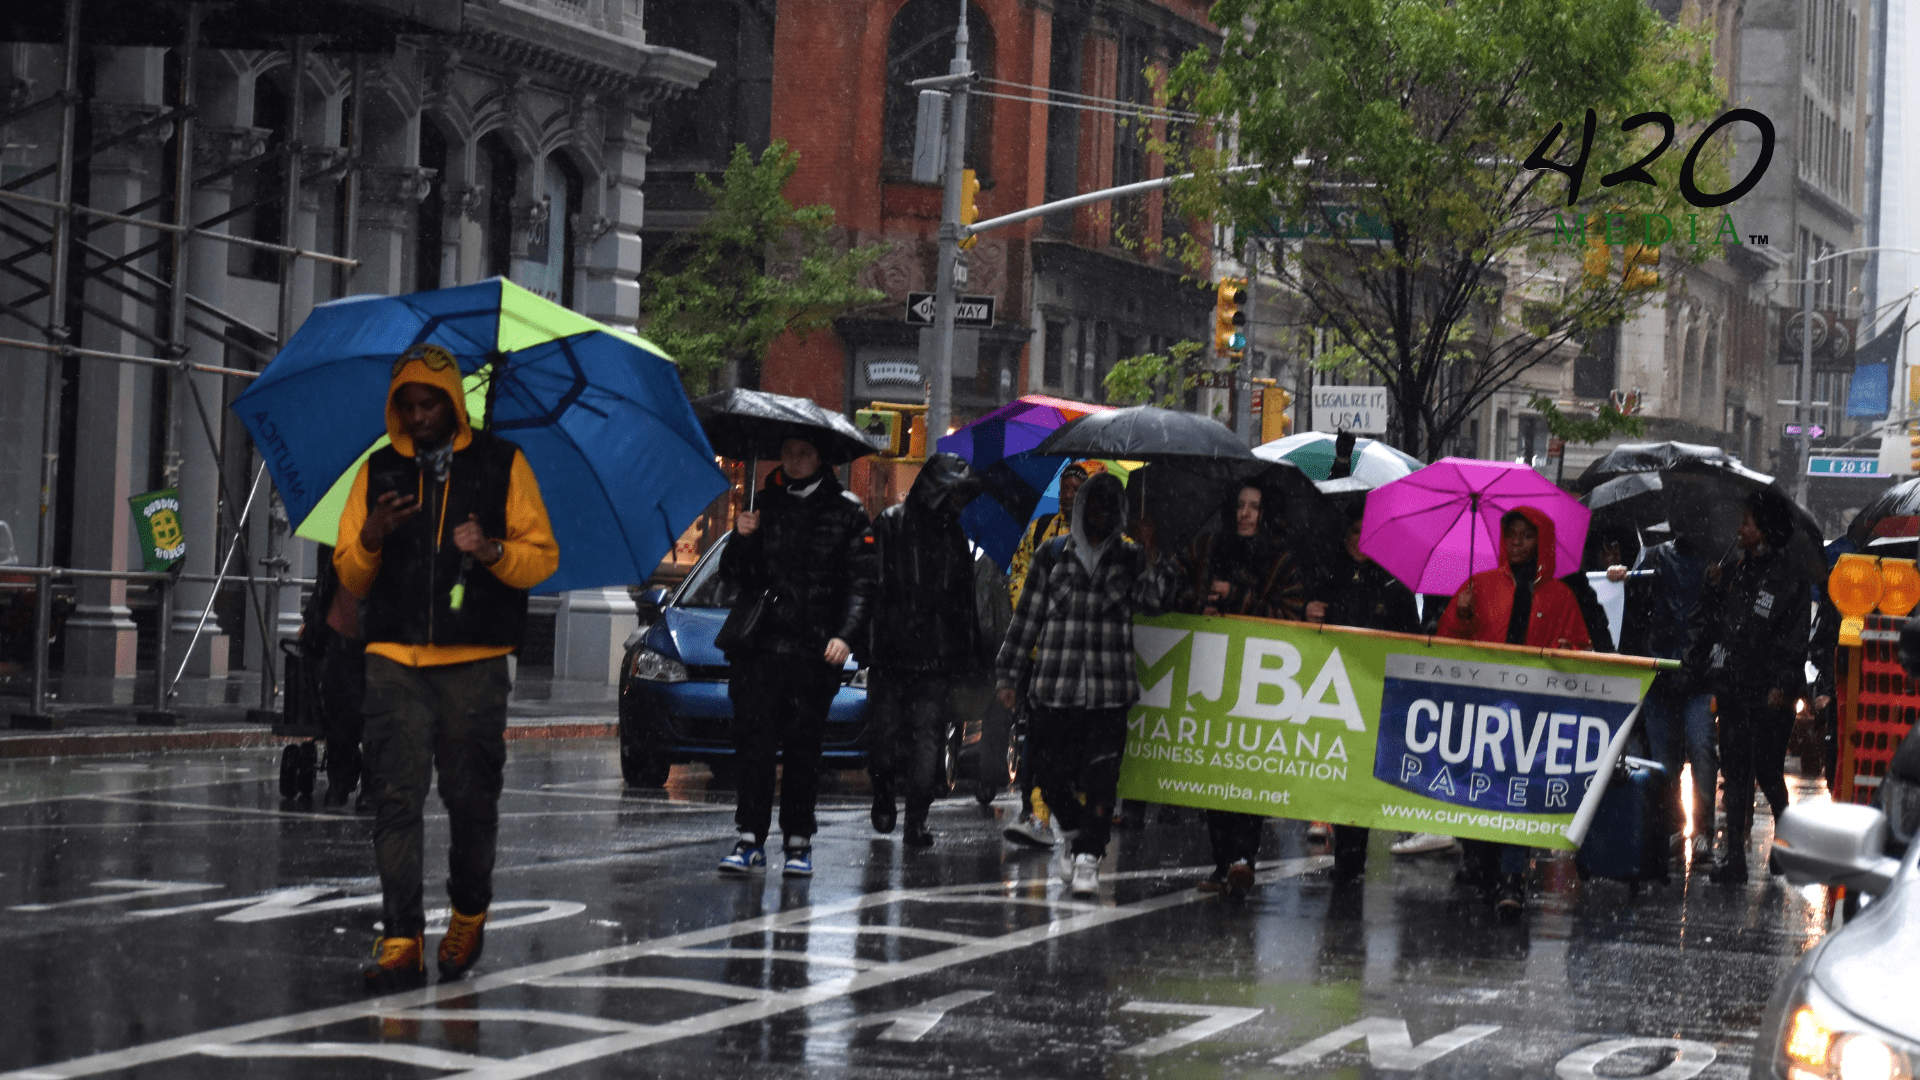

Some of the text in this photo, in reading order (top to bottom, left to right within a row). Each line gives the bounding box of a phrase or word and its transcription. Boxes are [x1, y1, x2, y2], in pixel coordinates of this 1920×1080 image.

[956, 304, 984, 317] WAY
[1315, 393, 1384, 409] LEGALIZE IT,
[1330, 411, 1371, 429] USA!
[1841, 461, 1855, 473] 20
[1132, 624, 1367, 732] MJBA
[1415, 662, 1612, 695] EASY TO ROLL
[1127, 712, 1348, 763] MARIJUANA
[1405, 699, 1610, 775] CURVED
[1124, 741, 1348, 782] USINESS ASSOCIATION
[1157, 778, 1291, 805] www.mjba.net
